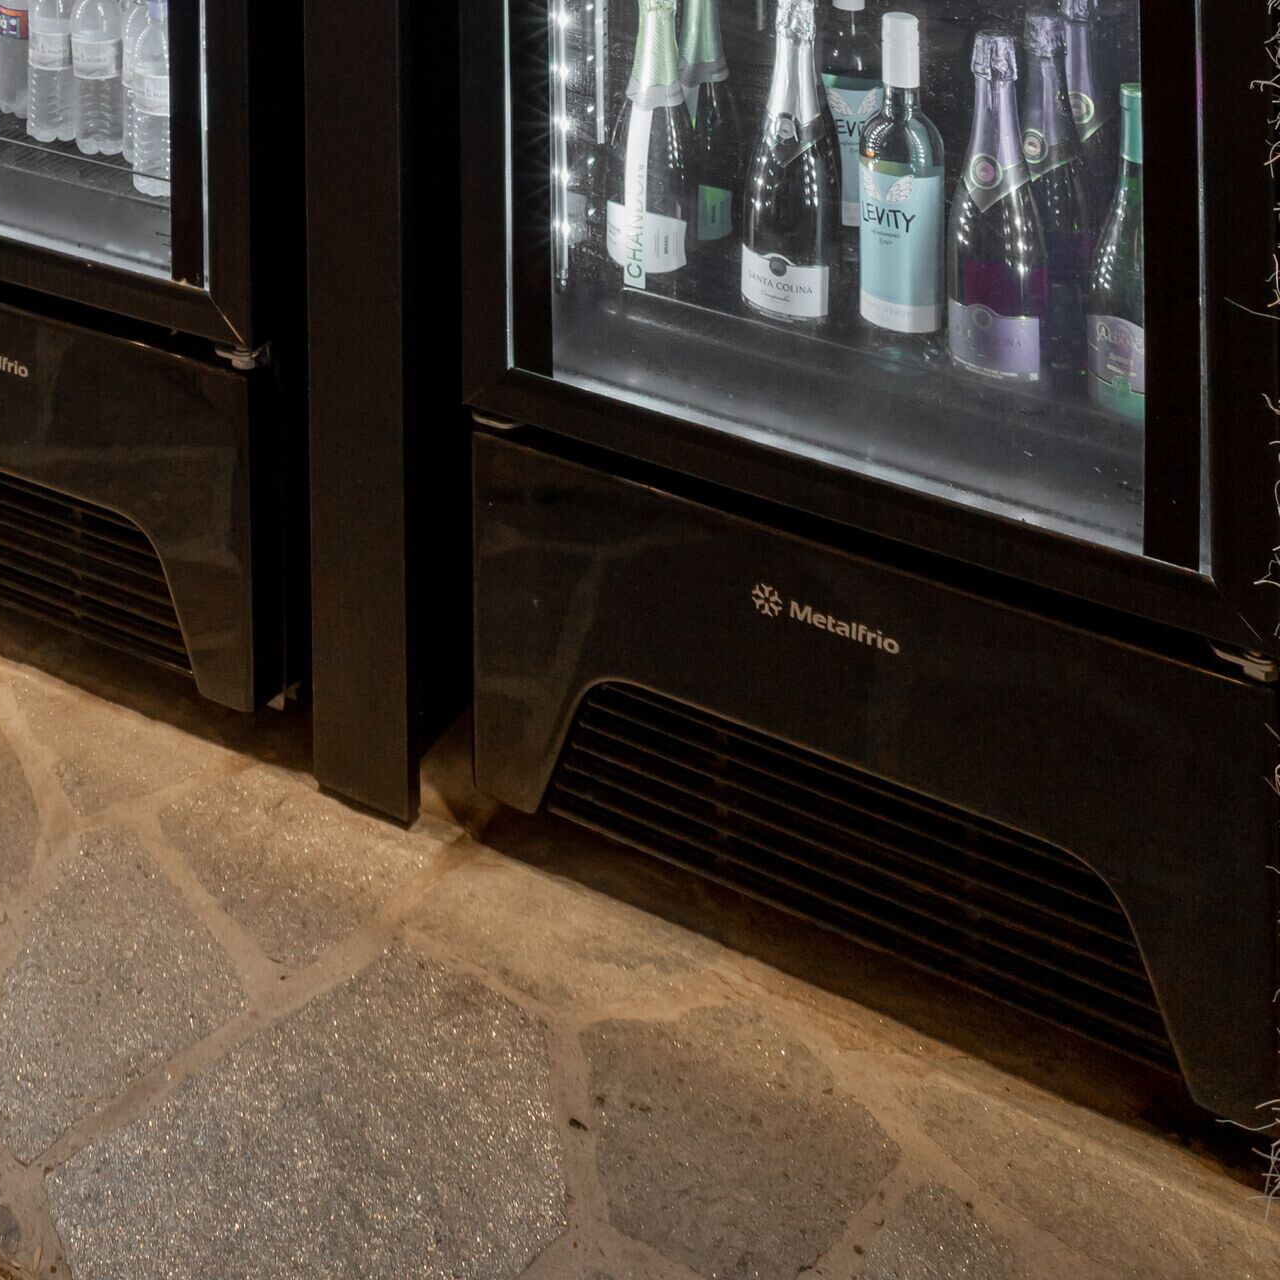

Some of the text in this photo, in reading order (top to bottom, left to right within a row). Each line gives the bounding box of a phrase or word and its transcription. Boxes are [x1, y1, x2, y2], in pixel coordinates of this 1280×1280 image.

[861, 199, 916, 234] LEVITY
[775, 281, 814, 295] COLINA
[789, 600, 901, 655] Metalfrio
